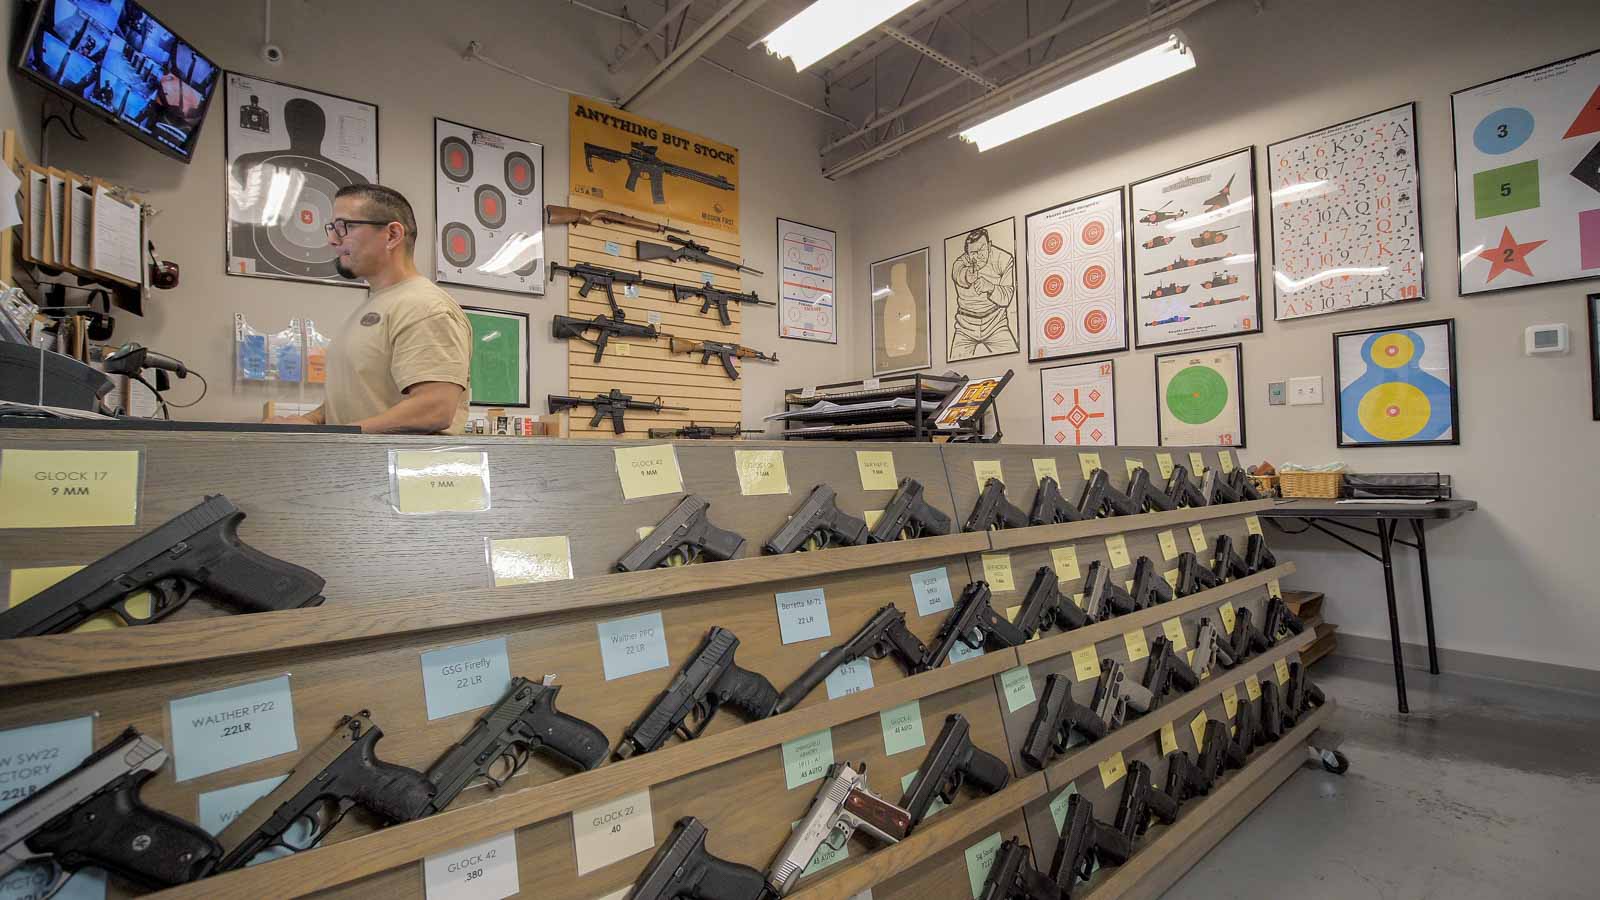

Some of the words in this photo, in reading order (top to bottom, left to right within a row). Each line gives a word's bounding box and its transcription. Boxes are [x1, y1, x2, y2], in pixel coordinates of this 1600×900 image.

[575, 104, 658, 141] ANYTHING
[662, 132, 690, 150] BUT
[694, 143, 735, 165] STOCK
[1333, 141, 1345, 153] K
[1354, 134, 1364, 146] 9
[1392, 123, 1408, 141] A
[1497, 124, 1509, 138] 3
[1359, 180, 1366, 192] 5
[1376, 174, 1386, 185] 9
[1398, 168, 1407, 181] 7
[1500, 182, 1512, 197] 5
[1283, 219, 1292, 230] 8
[1318, 210, 1331, 223] 10
[1337, 207, 1350, 222] A
[1356, 201, 1371, 216] Q
[1376, 196, 1391, 210] 10
[1360, 224, 1368, 237] 2
[1377, 219, 1392, 233] Q
[1340, 250, 1349, 262] 9
[1379, 242, 1393, 256] K
[1401, 238, 1410, 251] 2
[1503, 248, 1514, 263] 2
[1100, 364, 1111, 376] 12
[1218, 433, 1232, 445] 13
[34, 471, 88, 481] GLOCK
[94, 471, 108, 481] 17
[51, 487, 59, 496] 9
[63, 487, 89, 495] MM
[437, 480, 454, 488] MM
[798, 616, 806, 625] 22
[806, 615, 814, 624] LR
[625, 646, 635, 655] 22
[635, 643, 645, 653] LR
[441, 665, 462, 677] GSG
[464, 657, 491, 674] Firefly
[456, 678, 470, 689] 22
[470, 675, 483, 686] LR
[192, 707, 249, 728] WALTHER
[253, 701, 275, 714] P22
[220, 722, 252, 738] .22LR
[17, 747, 60, 762] SW22
[0, 762, 53, 784] CTORY
[808, 766, 823, 776] AUTO
[592, 811, 623, 828] GLOCK
[624, 806, 635, 816] 22
[447, 854, 483, 873] GLOCK
[485, 850, 497, 861] 42
[464, 868, 483, 882] .380
